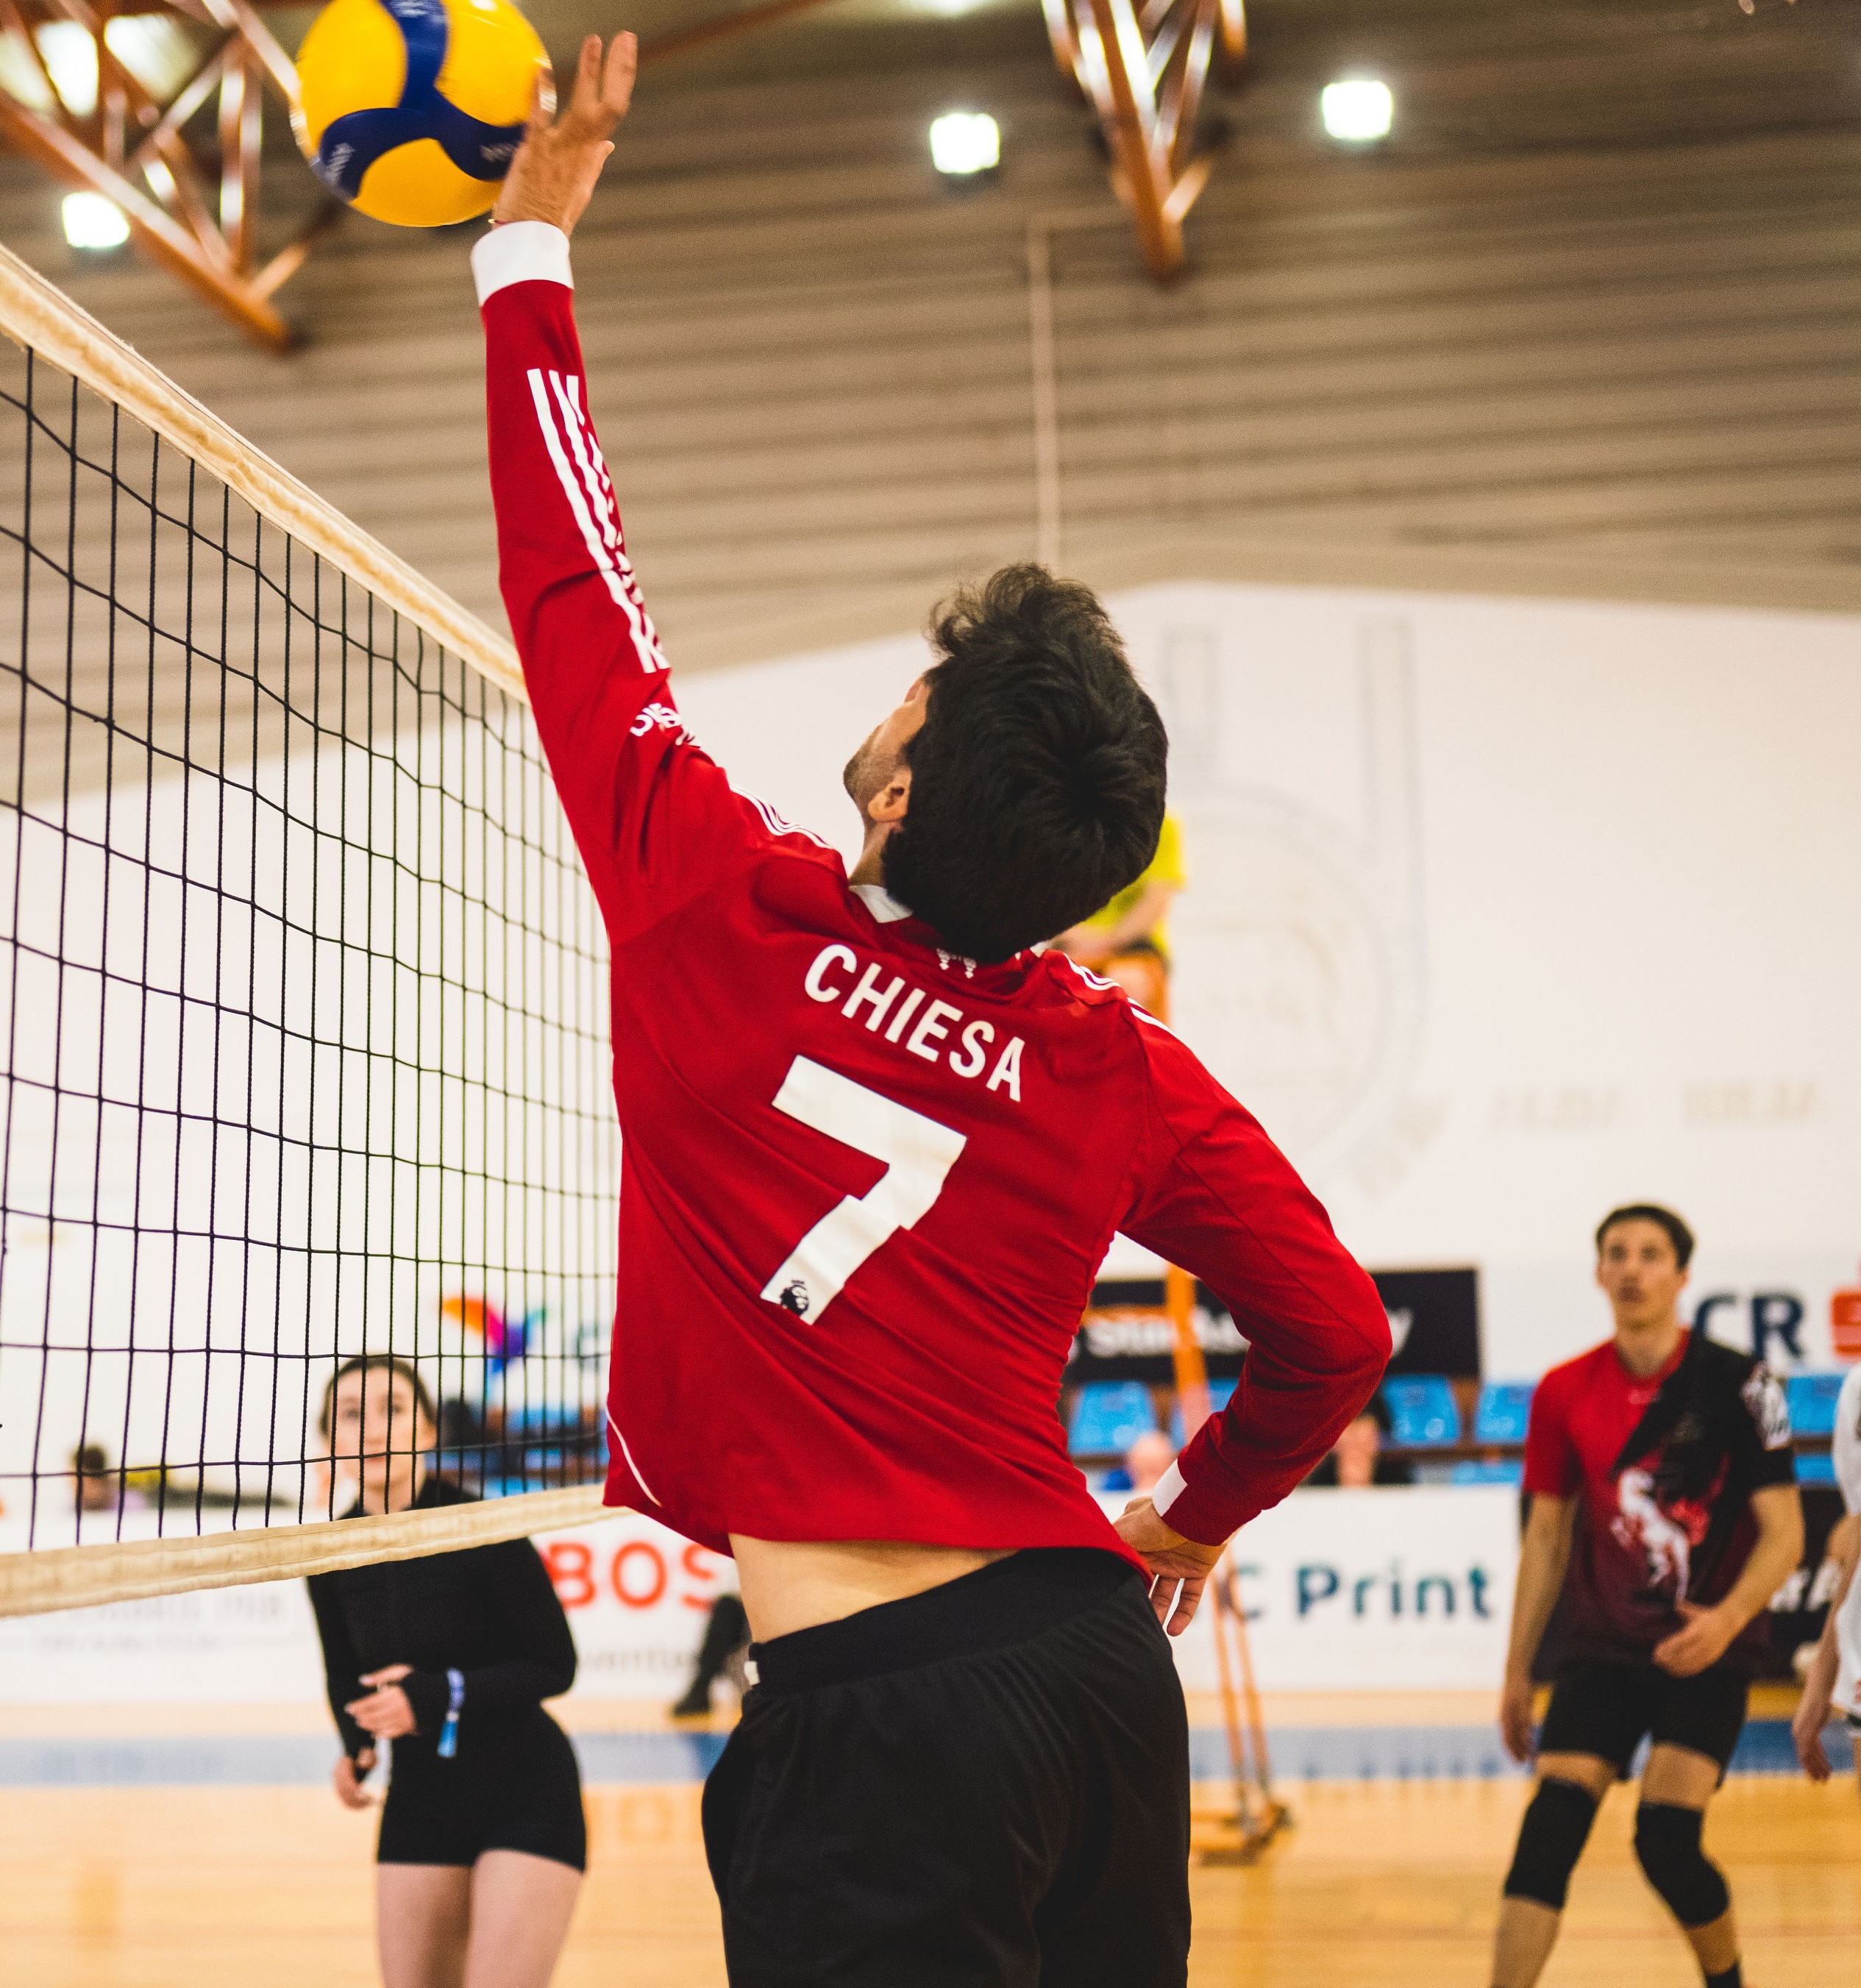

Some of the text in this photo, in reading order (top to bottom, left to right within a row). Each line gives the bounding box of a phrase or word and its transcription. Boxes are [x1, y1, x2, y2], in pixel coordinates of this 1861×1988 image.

[803, 944, 1026, 1102] CHIESA
[760, 1055, 967, 1326] 7
[1295, 1557, 1493, 1620] Print
